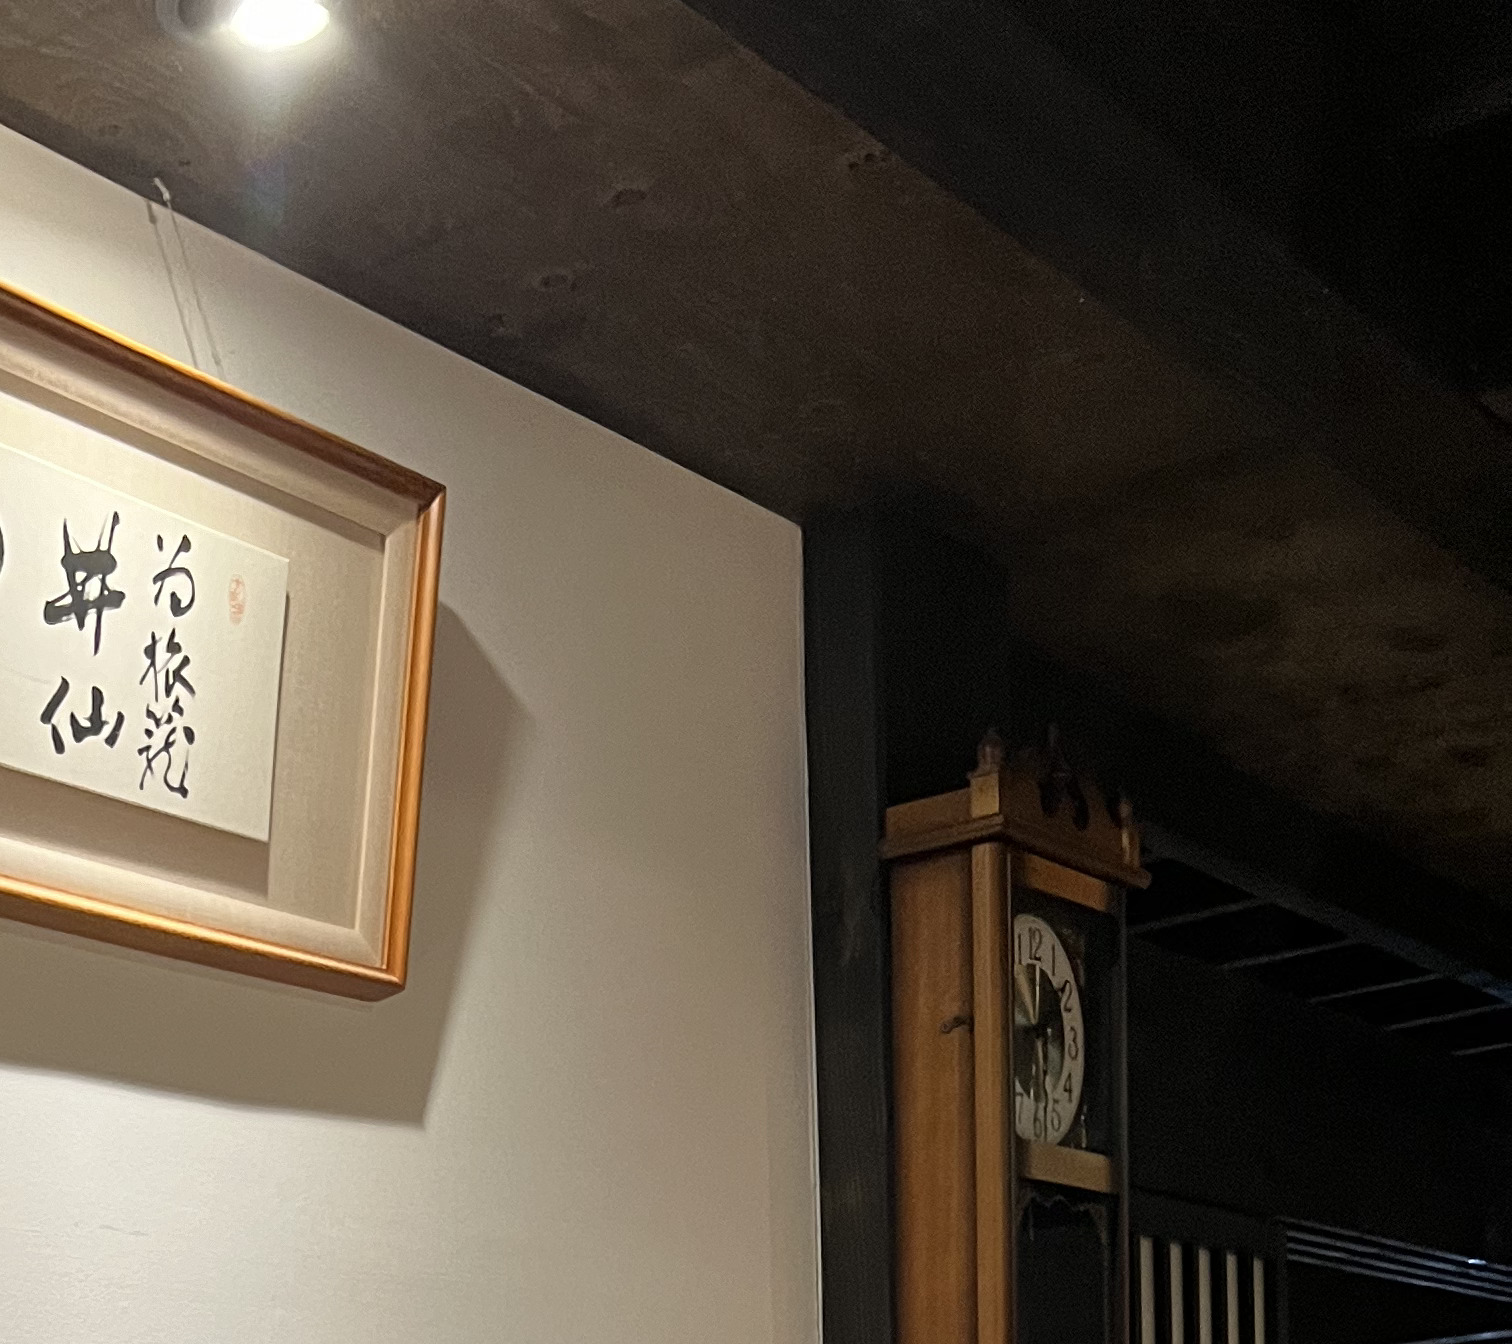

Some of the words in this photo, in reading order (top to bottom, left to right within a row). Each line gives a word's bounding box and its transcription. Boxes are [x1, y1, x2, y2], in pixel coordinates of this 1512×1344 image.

[1028, 926, 1043, 963] 12
[1059, 979, 1073, 1013] 2
[1067, 1025, 1079, 1061] 3
[1063, 1071, 1073, 1104] 4
[1051, 1098, 1062, 1133] 5
